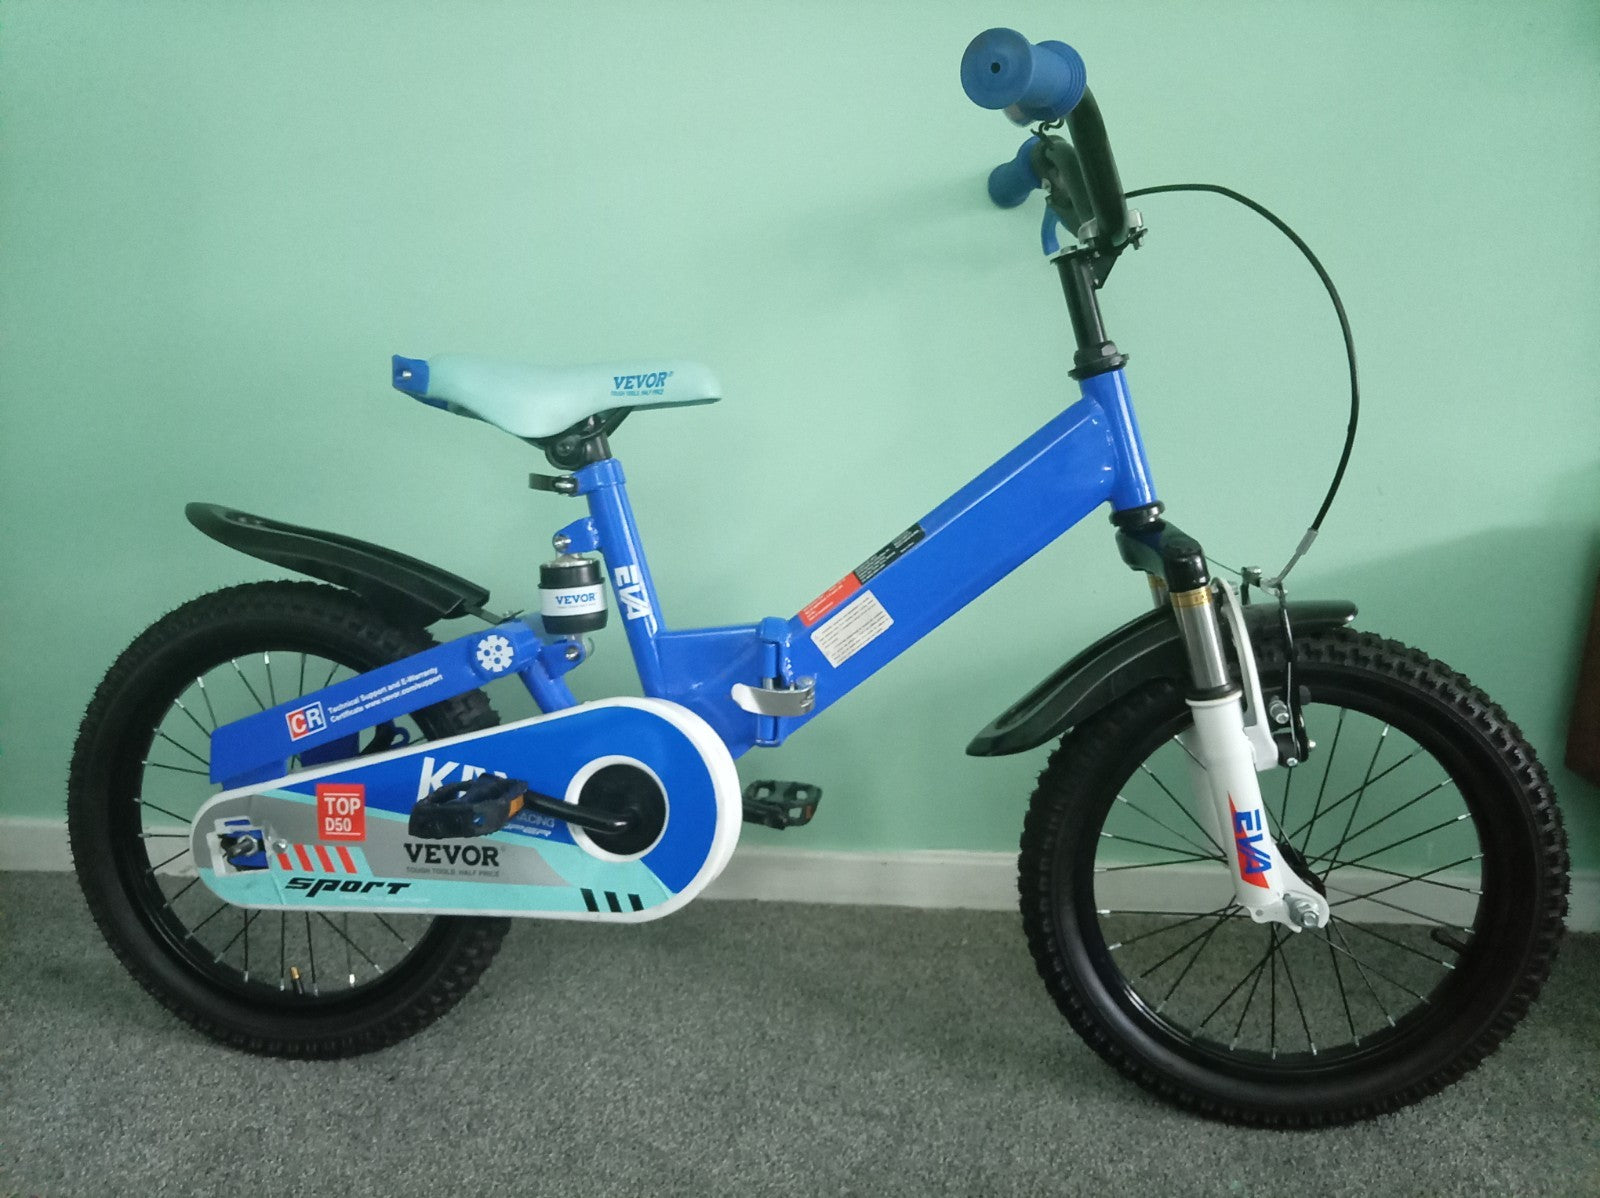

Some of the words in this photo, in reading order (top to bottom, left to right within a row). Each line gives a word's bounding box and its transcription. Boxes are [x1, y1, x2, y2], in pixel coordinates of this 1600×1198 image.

[613, 371, 667, 390] VEVOR
[555, 592, 596, 605] VEVOR
[614, 564, 651, 620] EVA
[328, 696, 360, 714] Technical
[360, 686, 387, 702] Support
[387, 681, 401, 691] and
[400, 667, 438, 685] E-Warranty
[291, 707, 324, 734] CR
[330, 705, 364, 722] Certificate
[323, 797, 361, 815] TOP
[325, 817, 352, 832] D50
[517, 811, 555, 828] ACING
[1235, 808, 1272, 874] EVA
[403, 843, 500, 867] VEVOR
